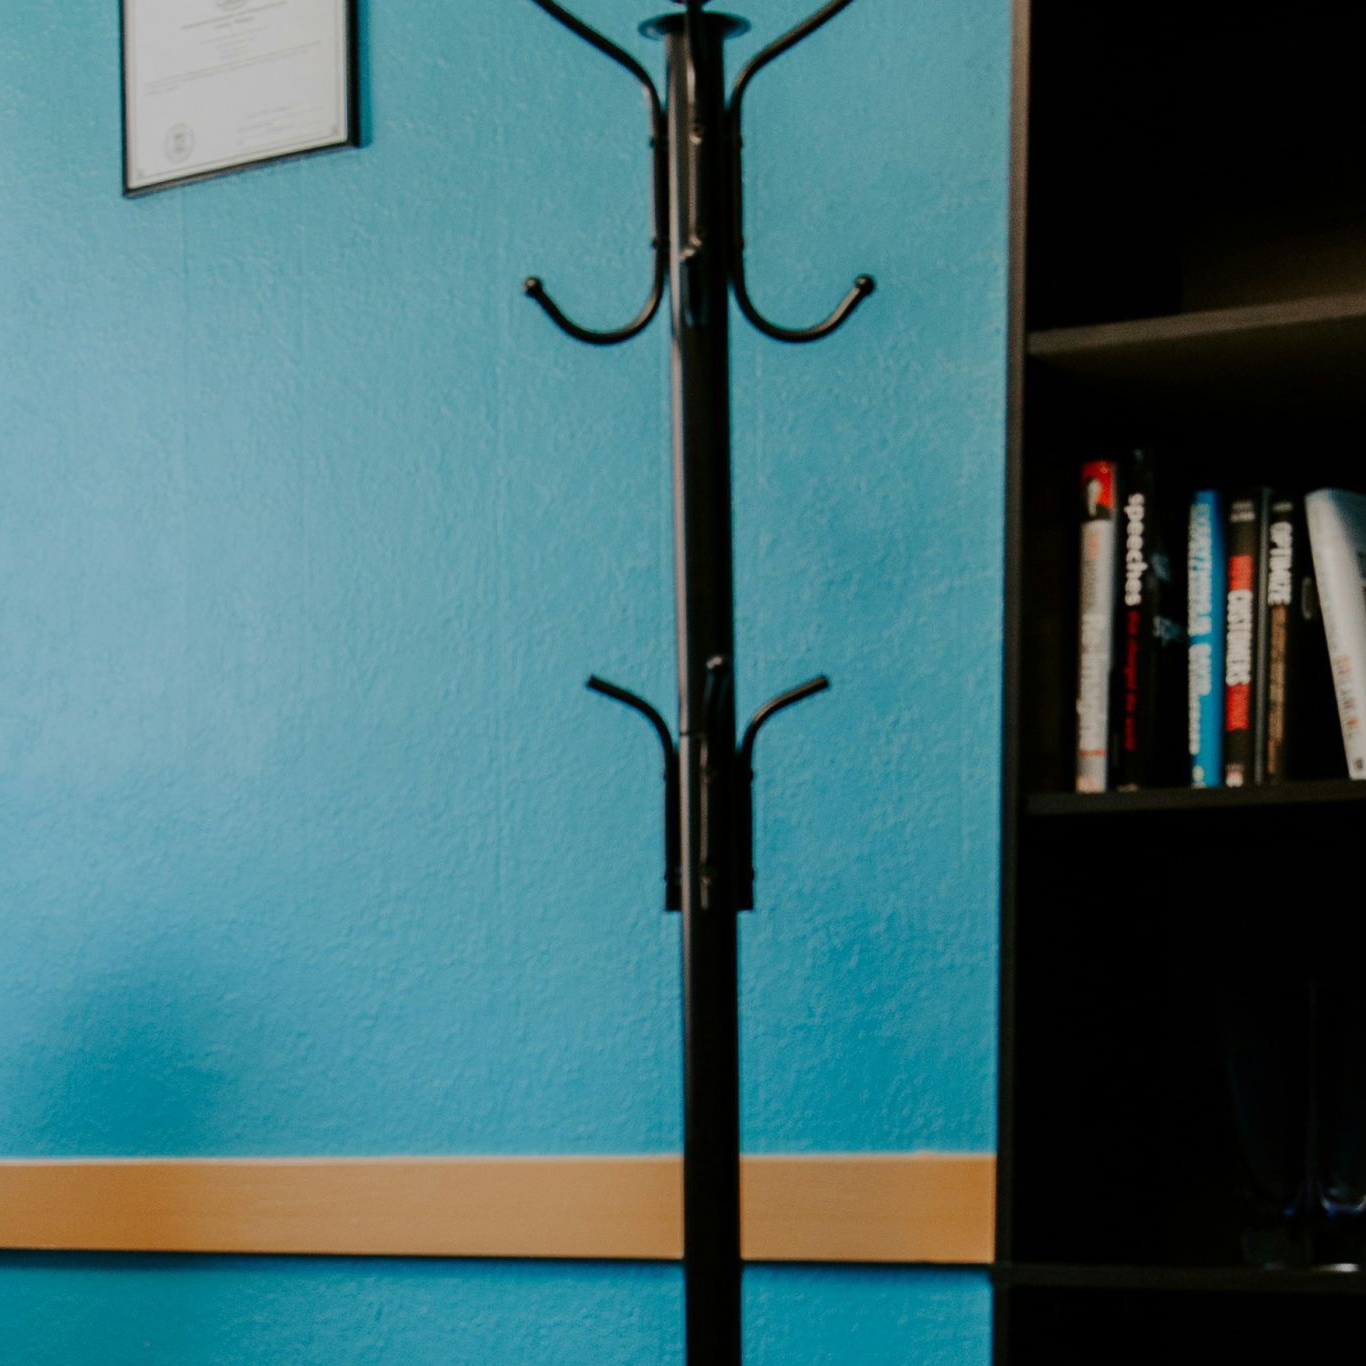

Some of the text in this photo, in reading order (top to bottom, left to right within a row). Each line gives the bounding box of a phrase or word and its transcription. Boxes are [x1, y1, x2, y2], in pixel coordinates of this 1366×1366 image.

[1123, 493, 1148, 606] speeches
[1267, 521, 1293, 606] OPTIMIZE
[1225, 589, 1253, 687] CUSTOMERS
